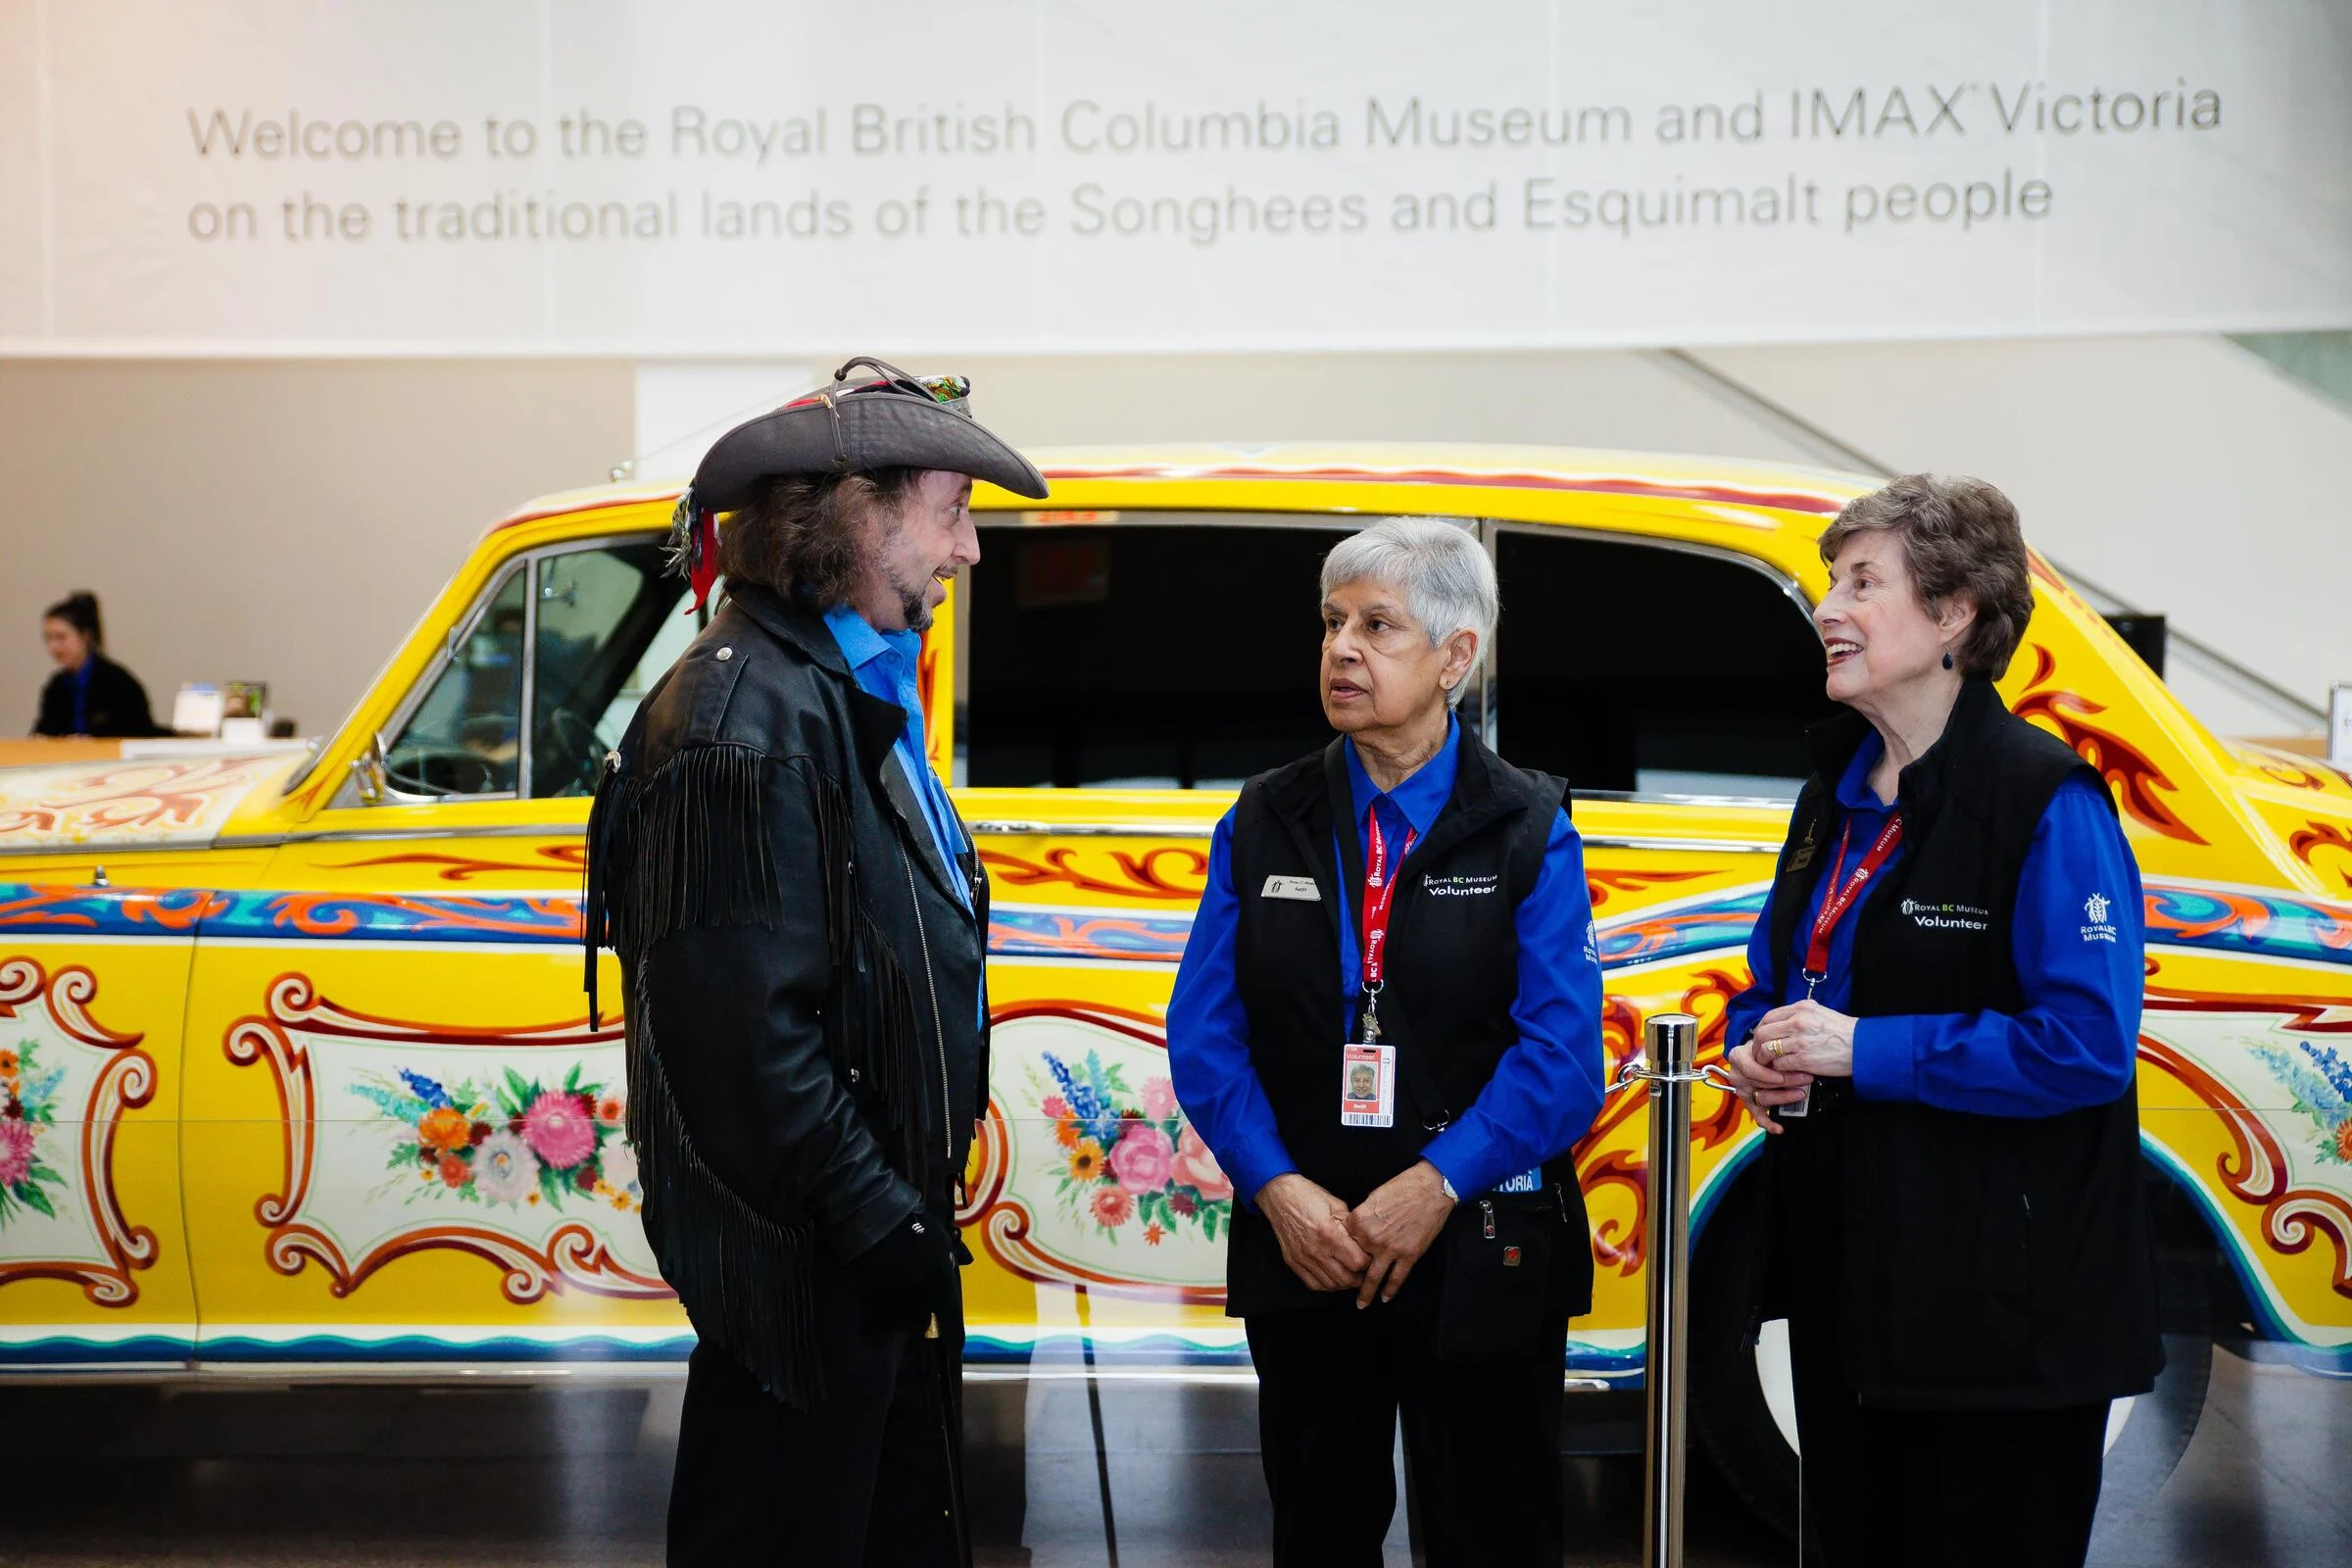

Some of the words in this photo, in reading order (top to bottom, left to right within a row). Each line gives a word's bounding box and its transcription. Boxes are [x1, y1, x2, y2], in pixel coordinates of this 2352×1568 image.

[187, 108, 462, 159] Welcome
[484, 116, 536, 158] to
[559, 107, 646, 158] the
[672, 105, 825, 168] Royal
[852, 102, 1035, 155] British
[1061, 99, 1339, 153] Columbia
[1367, 96, 1631, 148] Museum
[1655, 89, 1764, 145] and
[1989, 77, 2222, 136] Victoria
[188, 202, 257, 242] on
[280, 191, 370, 241] the
[394, 191, 679, 241] traditional
[703, 188, 852, 239] lands
[875, 185, 929, 237] of
[955, 187, 1045, 236] the
[1072, 182, 1367, 245] Songhees
[1392, 180, 1496, 232] and
[1524, 173, 1819, 237] Esquimalt
[1844, 168, 2053, 233] people
[1376, 844, 1383, 855] BC
[1374, 856, 1383, 877] ROYAL
[1429, 877, 1452, 886] ROYAL
[1465, 874, 1497, 884] MUSEUM
[1429, 885, 1497, 896] Volunteer
[1844, 878, 1859, 897] ROYAL
[1836, 896, 1846, 907] BC
[1941, 904, 1955, 912] BC
[1914, 915, 1988, 931] Volunteer
[2081, 925, 2108, 934] ROYAL
